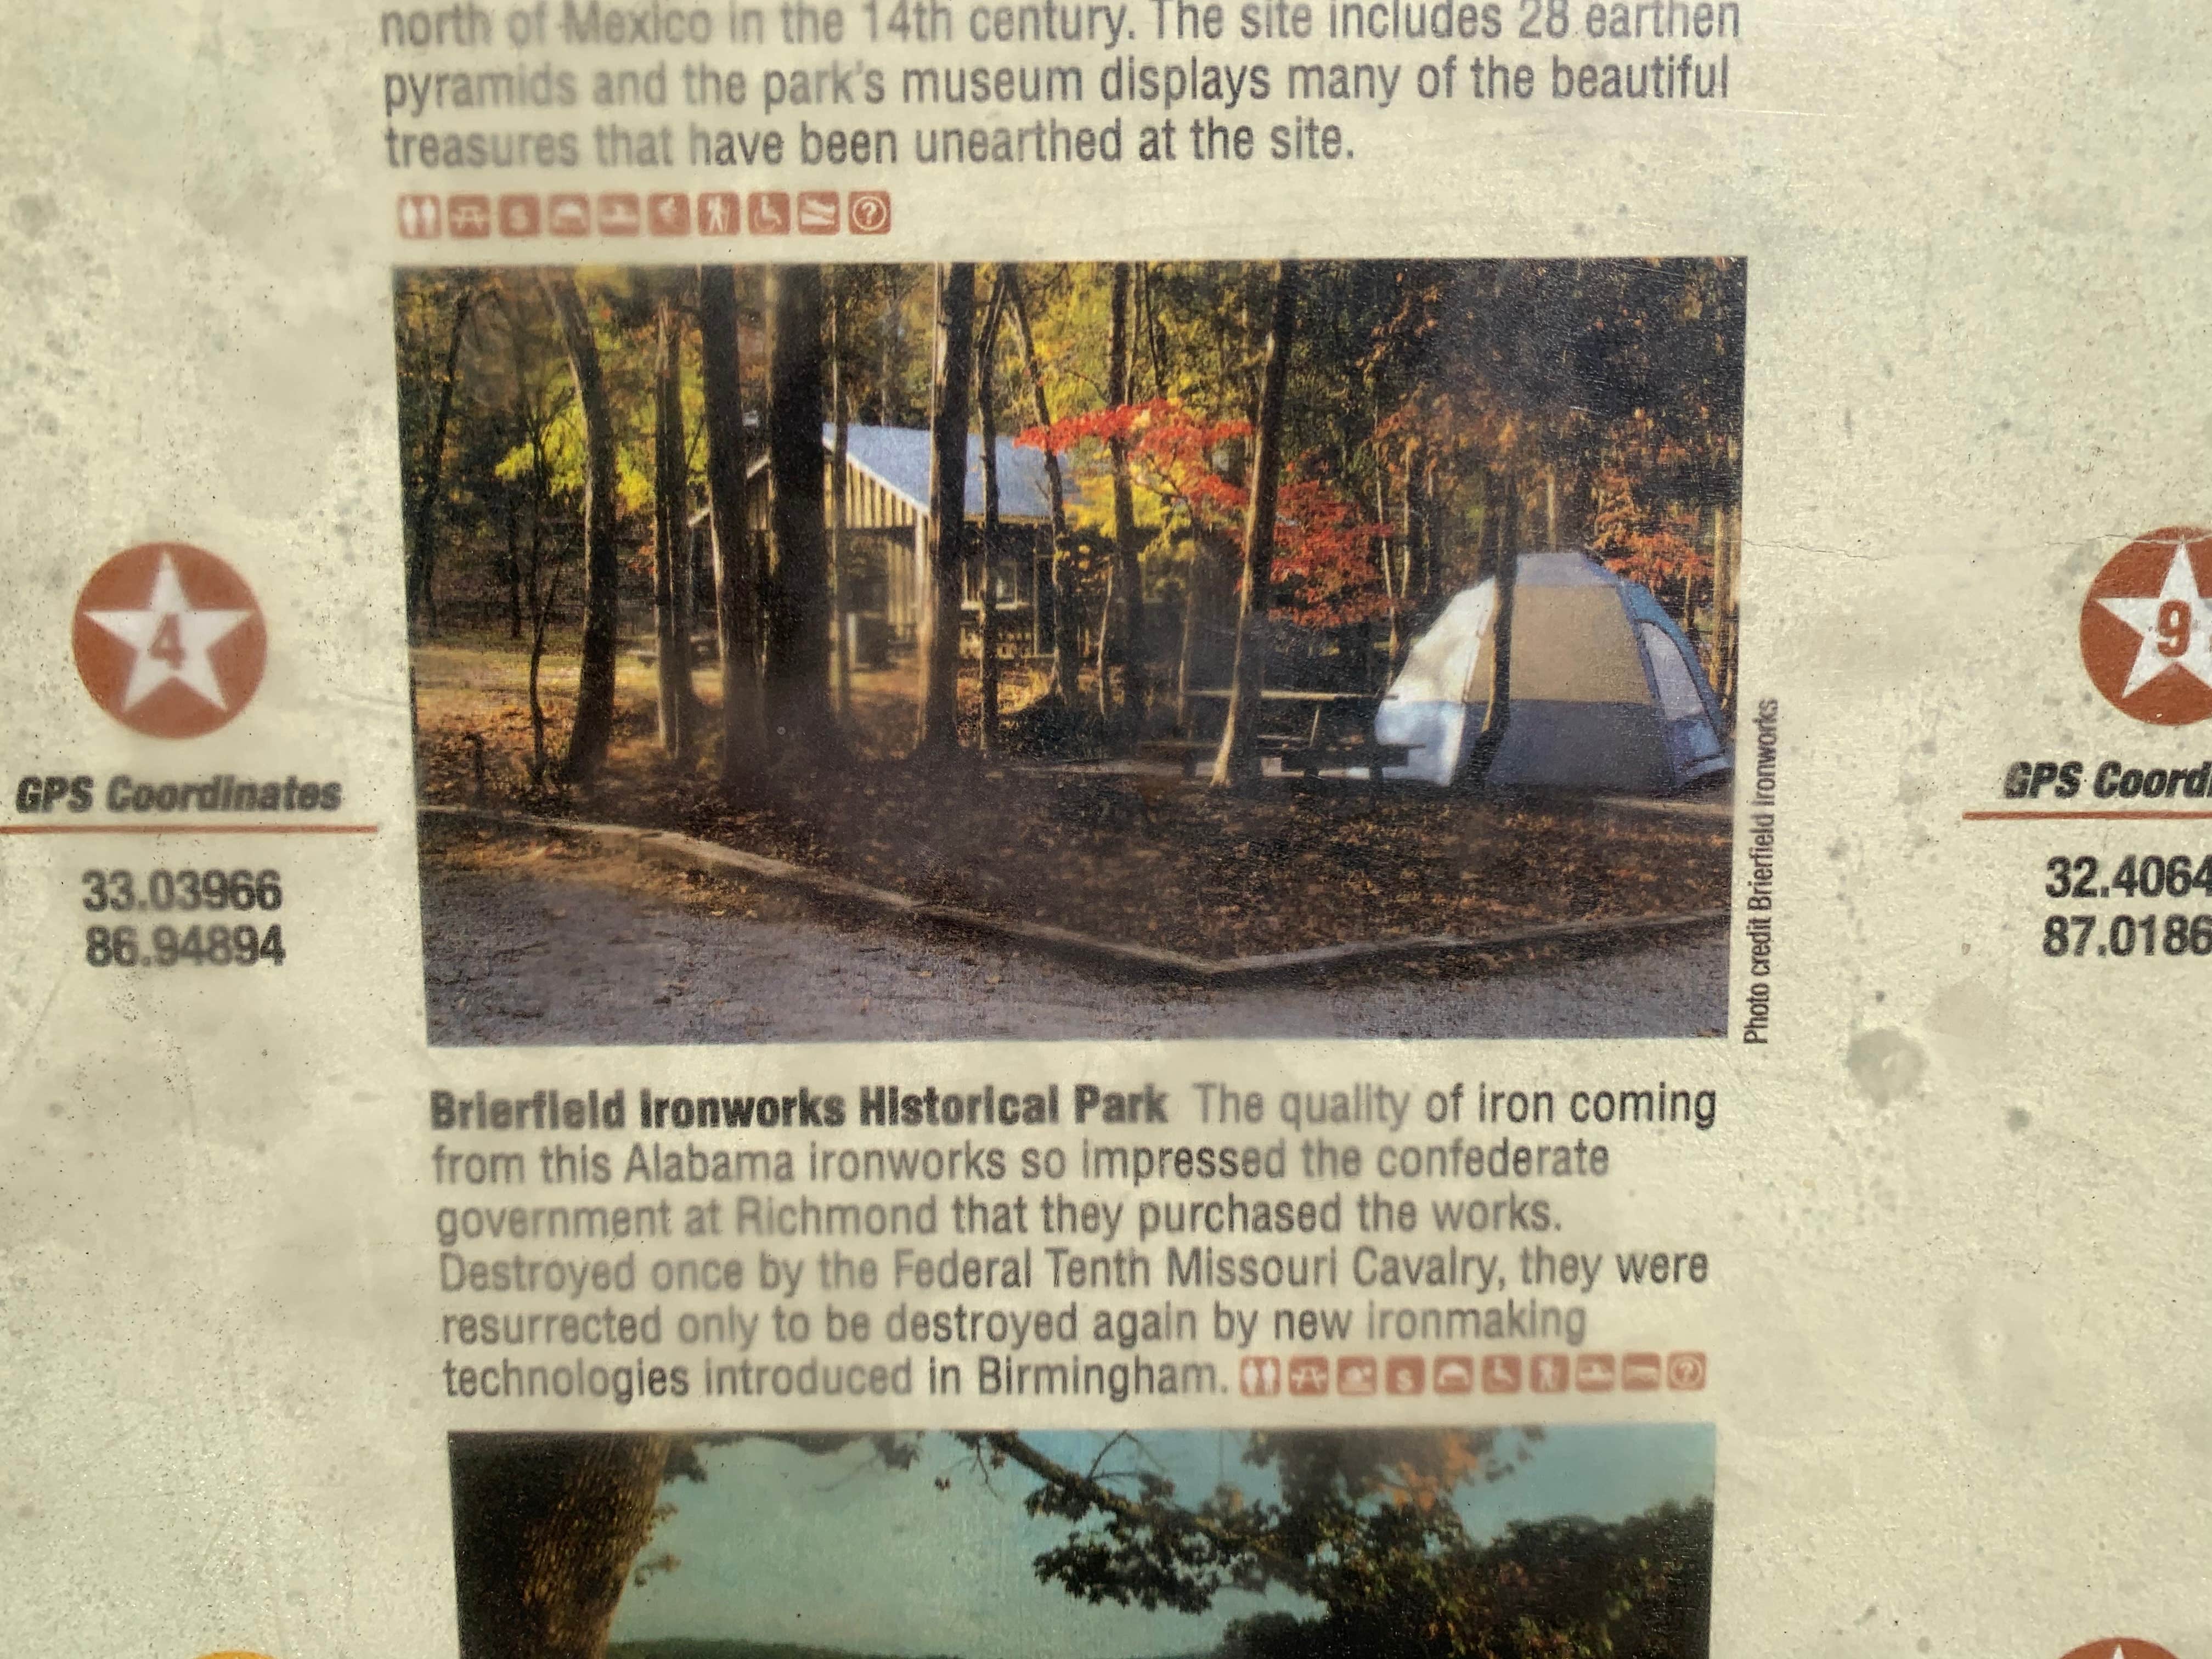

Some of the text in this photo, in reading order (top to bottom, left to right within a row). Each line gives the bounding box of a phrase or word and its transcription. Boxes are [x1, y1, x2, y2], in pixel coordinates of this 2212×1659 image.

[381, 0, 1741, 50] north of Mexico in the 14th century. The site includes 28 earthen
[383, 53, 1729, 120] pyramids and the park's museum displays many of the beautiful
[383, 115, 1354, 169] treasures that have been unearthed at the site.
[150, 612, 186, 670] 4
[2157, 600, 2191, 658] 9
[15, 774, 342, 814] GPS Coordinates
[2004, 760, 2084, 799] GPS
[82, 868, 283, 912] 33.03966
[1743, 698, 1778, 1044] Photo credit Brierfield Ironworks
[86, 923, 286, 968] 86.94894
[430, 1081, 1717, 1133] Brierfield Ironworks Historical Park The quality of iron coming
[431, 1136, 1609, 1187] from this Alabama ironworks so impressed the confederate
[435, 1190, 1561, 1249] government at Richmond that they purchased the works.
[439, 1244, 1708, 1300] Destroyed once by the Federal Tenth Missouri Cavalry, they were
[442, 1297, 1587, 1353] resurrected only to be destroyed again by new ironmaking
[442, 1354, 1227, 1406] technologies introduced in Birmingham.
